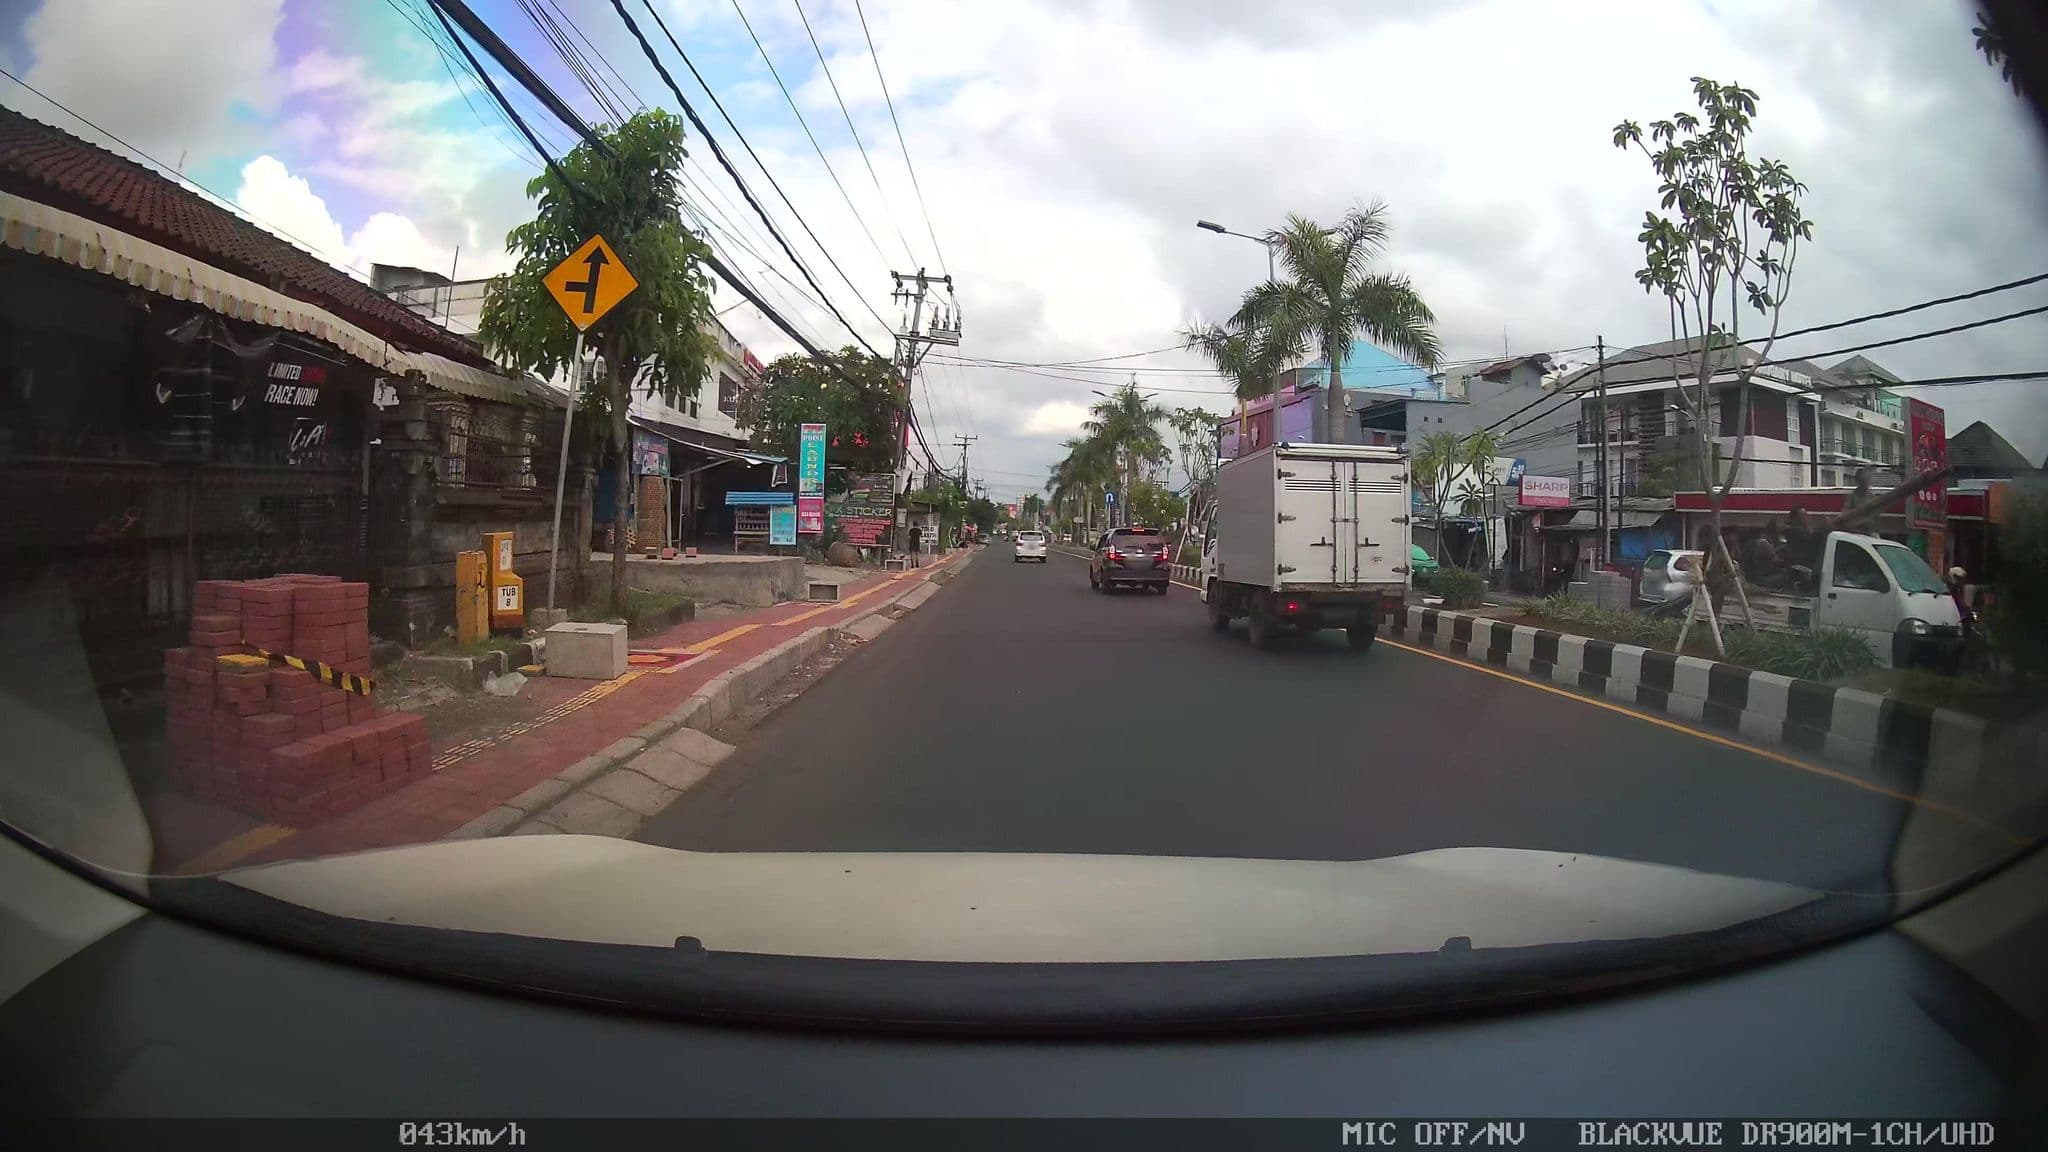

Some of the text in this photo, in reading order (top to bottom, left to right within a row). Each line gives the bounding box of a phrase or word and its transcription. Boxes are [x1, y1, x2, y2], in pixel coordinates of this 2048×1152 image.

[267, 362, 302, 380] LIMITED
[264, 384, 319, 407] RACE NOW!
[1524, 481, 1568, 492] SHARP
[846, 506, 892, 517] STICKER
[501, 587, 516, 597] TUB
